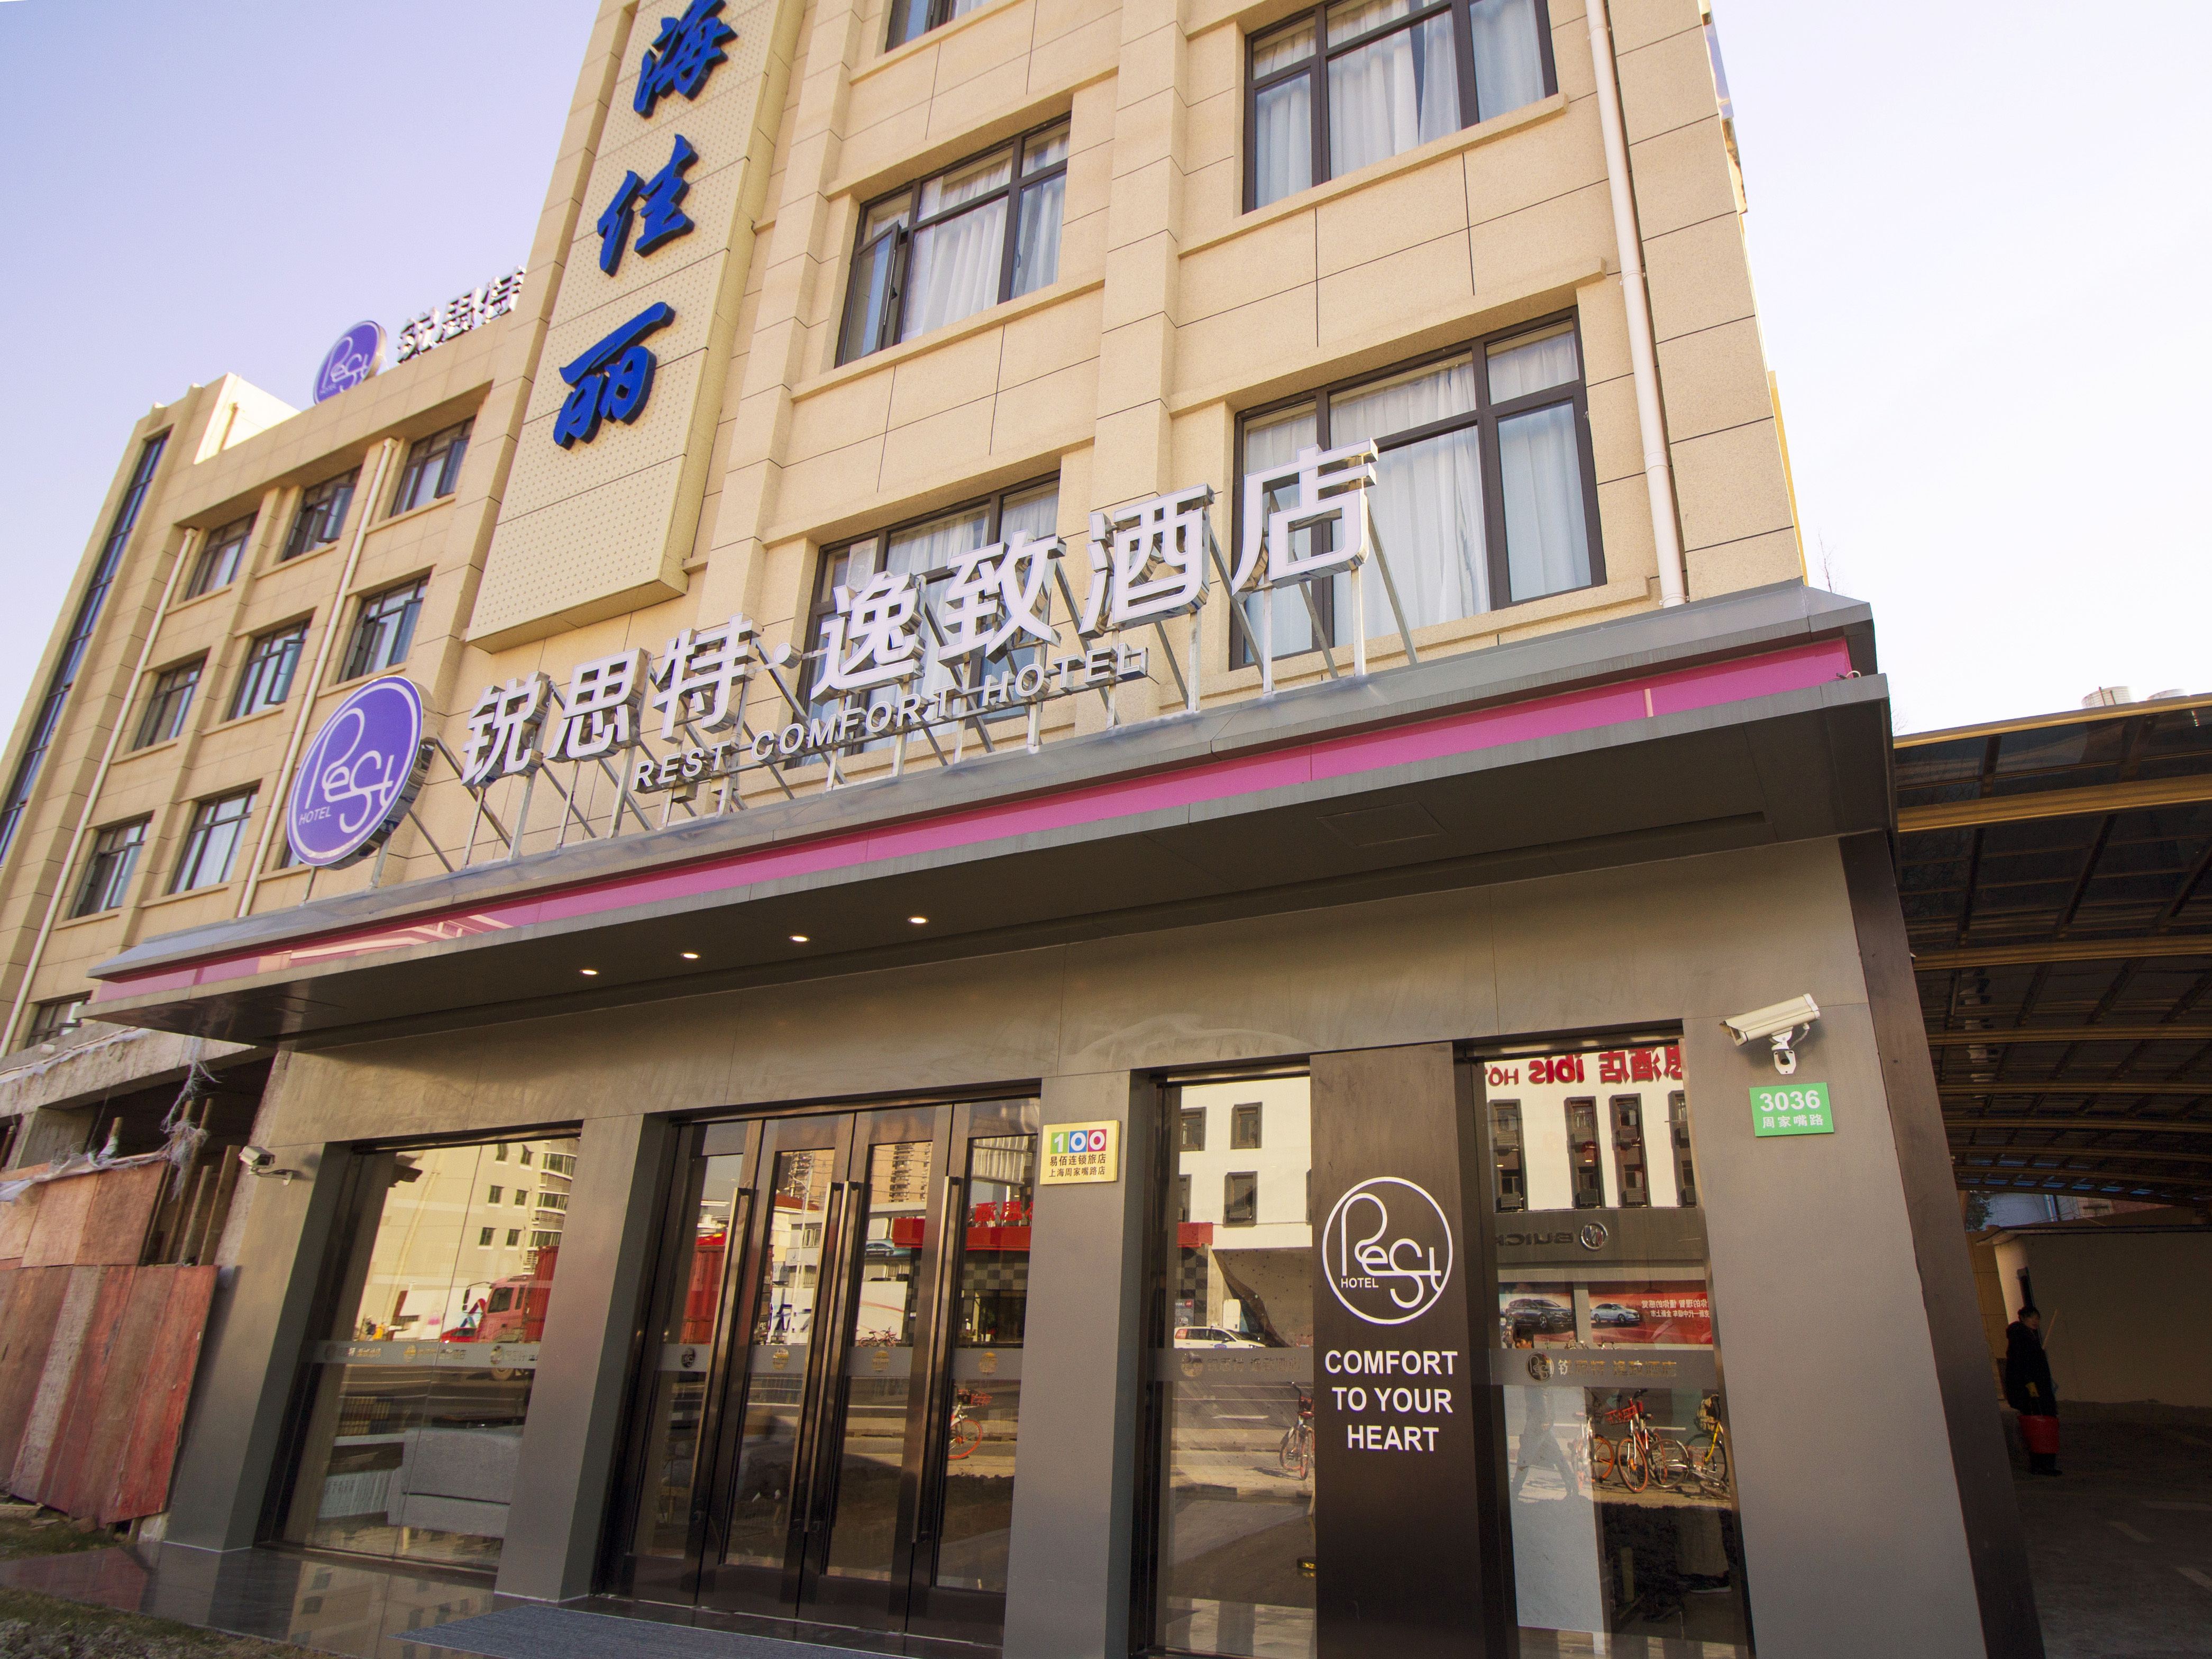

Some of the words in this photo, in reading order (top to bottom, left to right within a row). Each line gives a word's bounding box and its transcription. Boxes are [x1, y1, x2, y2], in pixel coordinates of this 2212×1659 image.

[633, 741, 734, 792] REST
[751, 684, 961, 762] COMFORT
[982, 643, 1147, 708] HOTEL
[299, 807, 332, 825] HOTEL
[1759, 1090, 1820, 1111] 3036
[1762, 1114, 1823, 1128] 周家嘴路
[1054, 1131, 1105, 1153] 100
[1049, 1153, 1107, 1166] 易佰连锁旅店
[1049, 1166, 1105, 1178] 上海周家嘴路店
[1341, 1278, 1379, 1288] HOTEL
[1325, 1350, 1458, 1374] COMFORT
[1331, 1387, 1367, 1411] TO
[1374, 1387, 1453, 1413] YOUR
[1347, 1425, 1439, 1452] HEART
